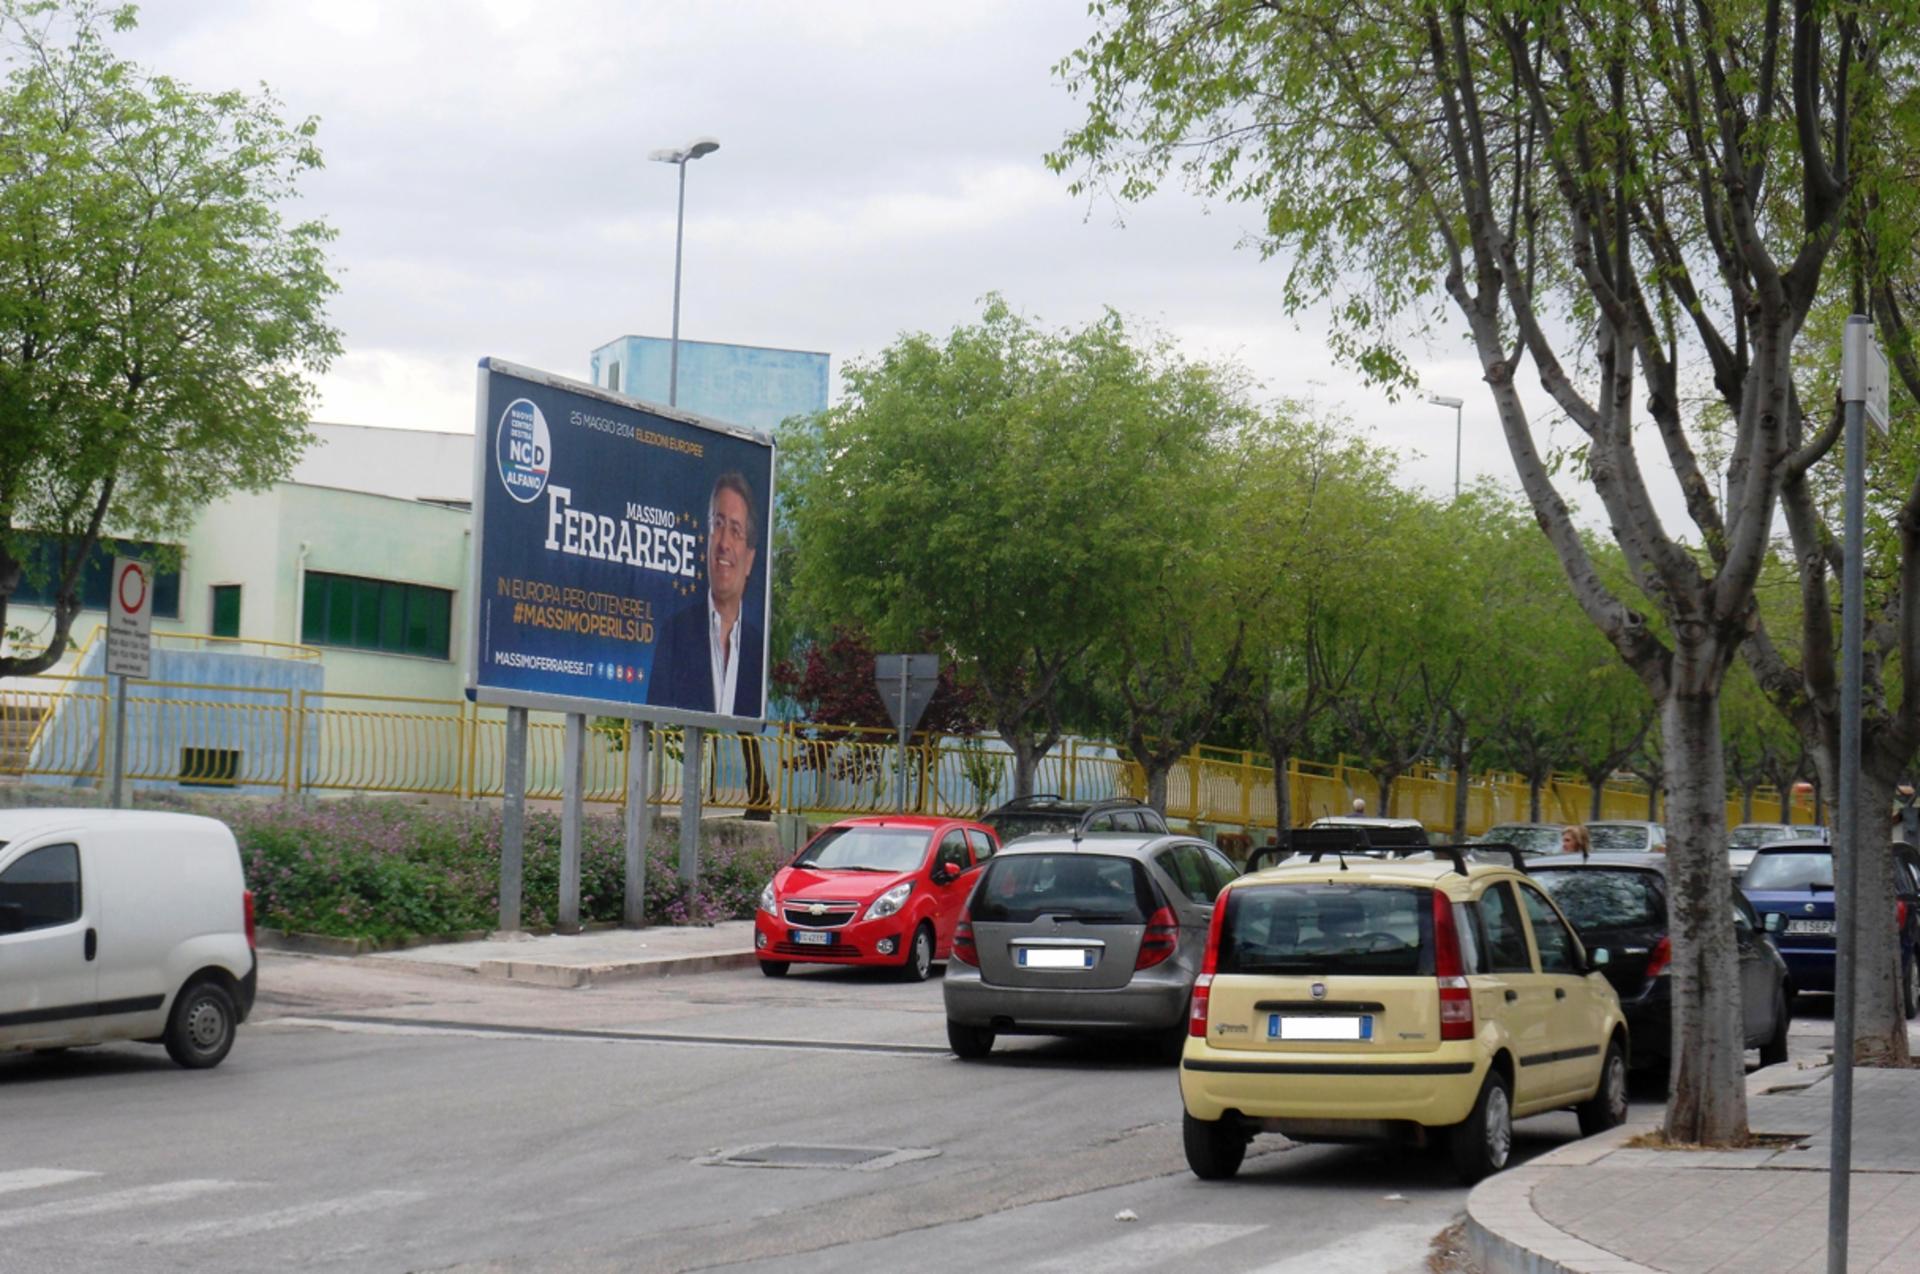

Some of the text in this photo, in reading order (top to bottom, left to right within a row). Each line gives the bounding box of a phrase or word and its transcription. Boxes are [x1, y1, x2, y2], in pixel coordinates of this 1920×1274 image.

[570, 411, 703, 458] 25 MAGGIO 2014 ELEZIONI EUROPEE
[509, 439, 545, 466] NCD
[507, 472, 541, 490] ALFANO
[545, 484, 696, 577] FERRARESE
[626, 501, 675, 528] MASSIMO
[498, 576, 654, 621] IN EUROPA PER OTTENERE IL
[513, 602, 654, 643] #MASSIMOPERILSUD
[495, 651, 594, 677] MASSIMOFERRARESE.IT
